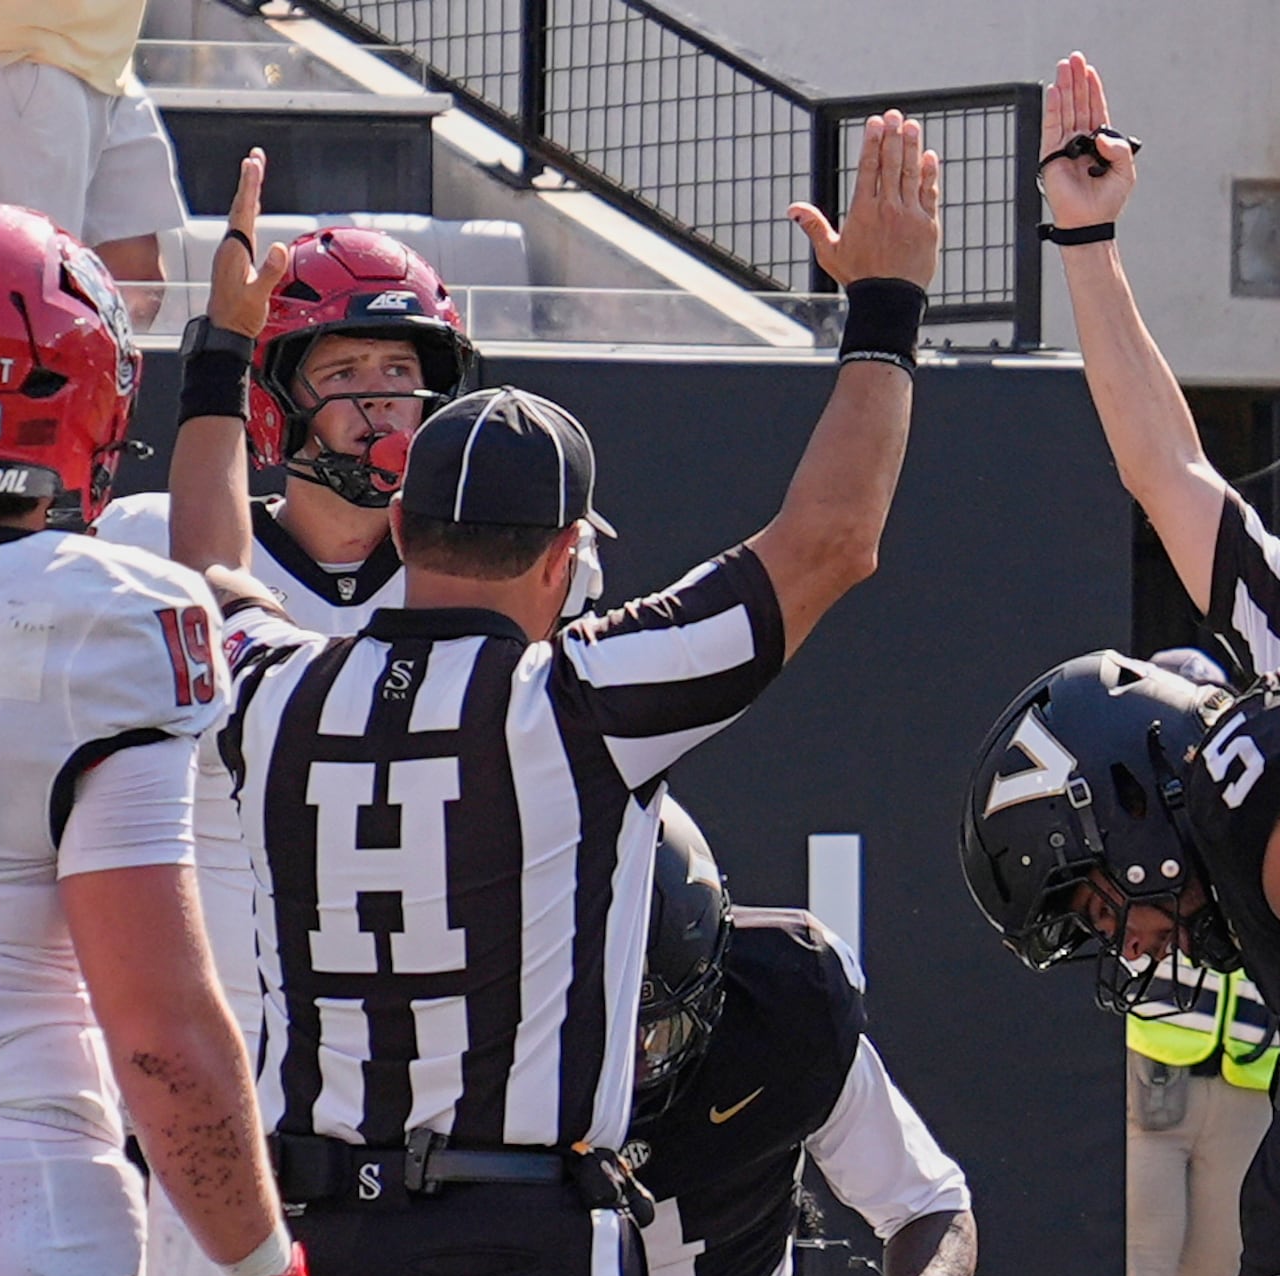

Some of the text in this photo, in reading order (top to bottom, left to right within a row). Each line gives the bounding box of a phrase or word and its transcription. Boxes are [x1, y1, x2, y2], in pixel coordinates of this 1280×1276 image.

[366, 290, 418, 310] ACC
[154, 605, 216, 707] 19
[982, 702, 1079, 819] V
[1202, 711, 1266, 810] 5
[305, 756, 467, 975] H
